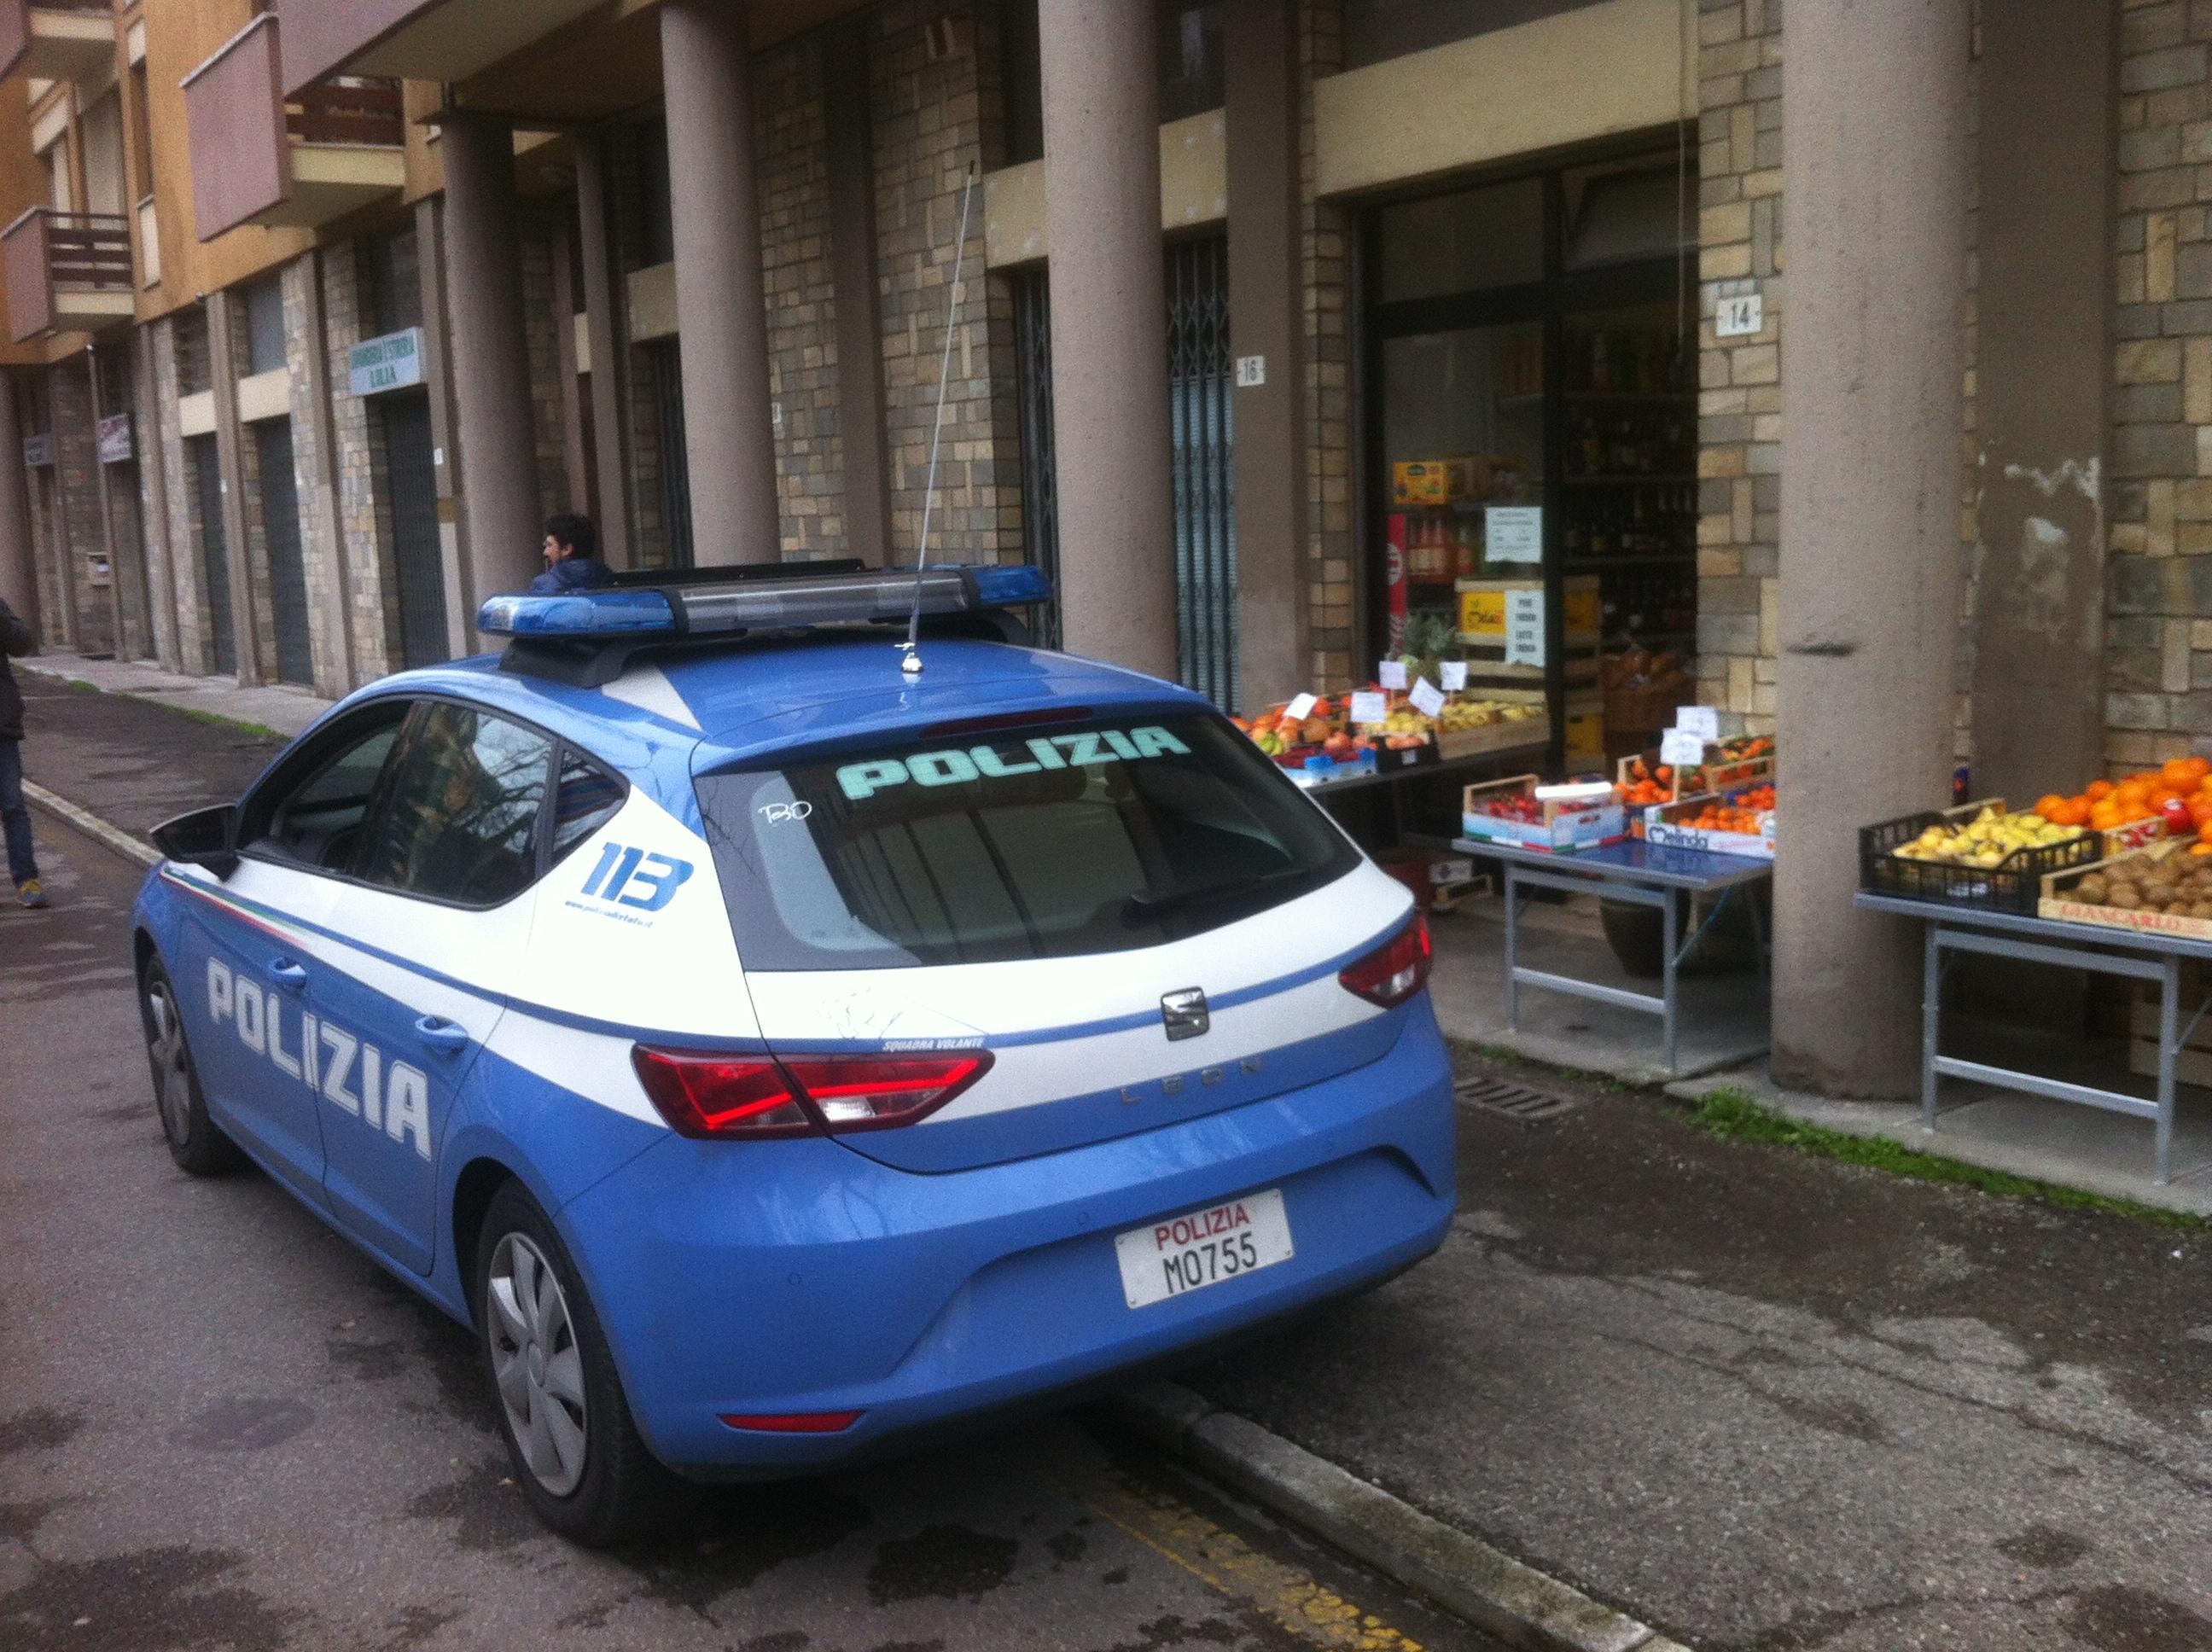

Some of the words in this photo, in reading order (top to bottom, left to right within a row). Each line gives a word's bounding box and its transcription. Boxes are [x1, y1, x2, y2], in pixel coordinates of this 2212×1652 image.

[1731, 300, 1749, 329] 14
[835, 725, 1192, 800] POLIZIA
[1649, 825, 1709, 849] Melinda
[580, 841, 695, 912] 113
[207, 956, 430, 1161] POLIZIA
[882, 1039, 934, 1052] SQUADRA
[936, 1036, 986, 1050] VOLANTE
[1155, 1204, 1250, 1251] POLIZIA
